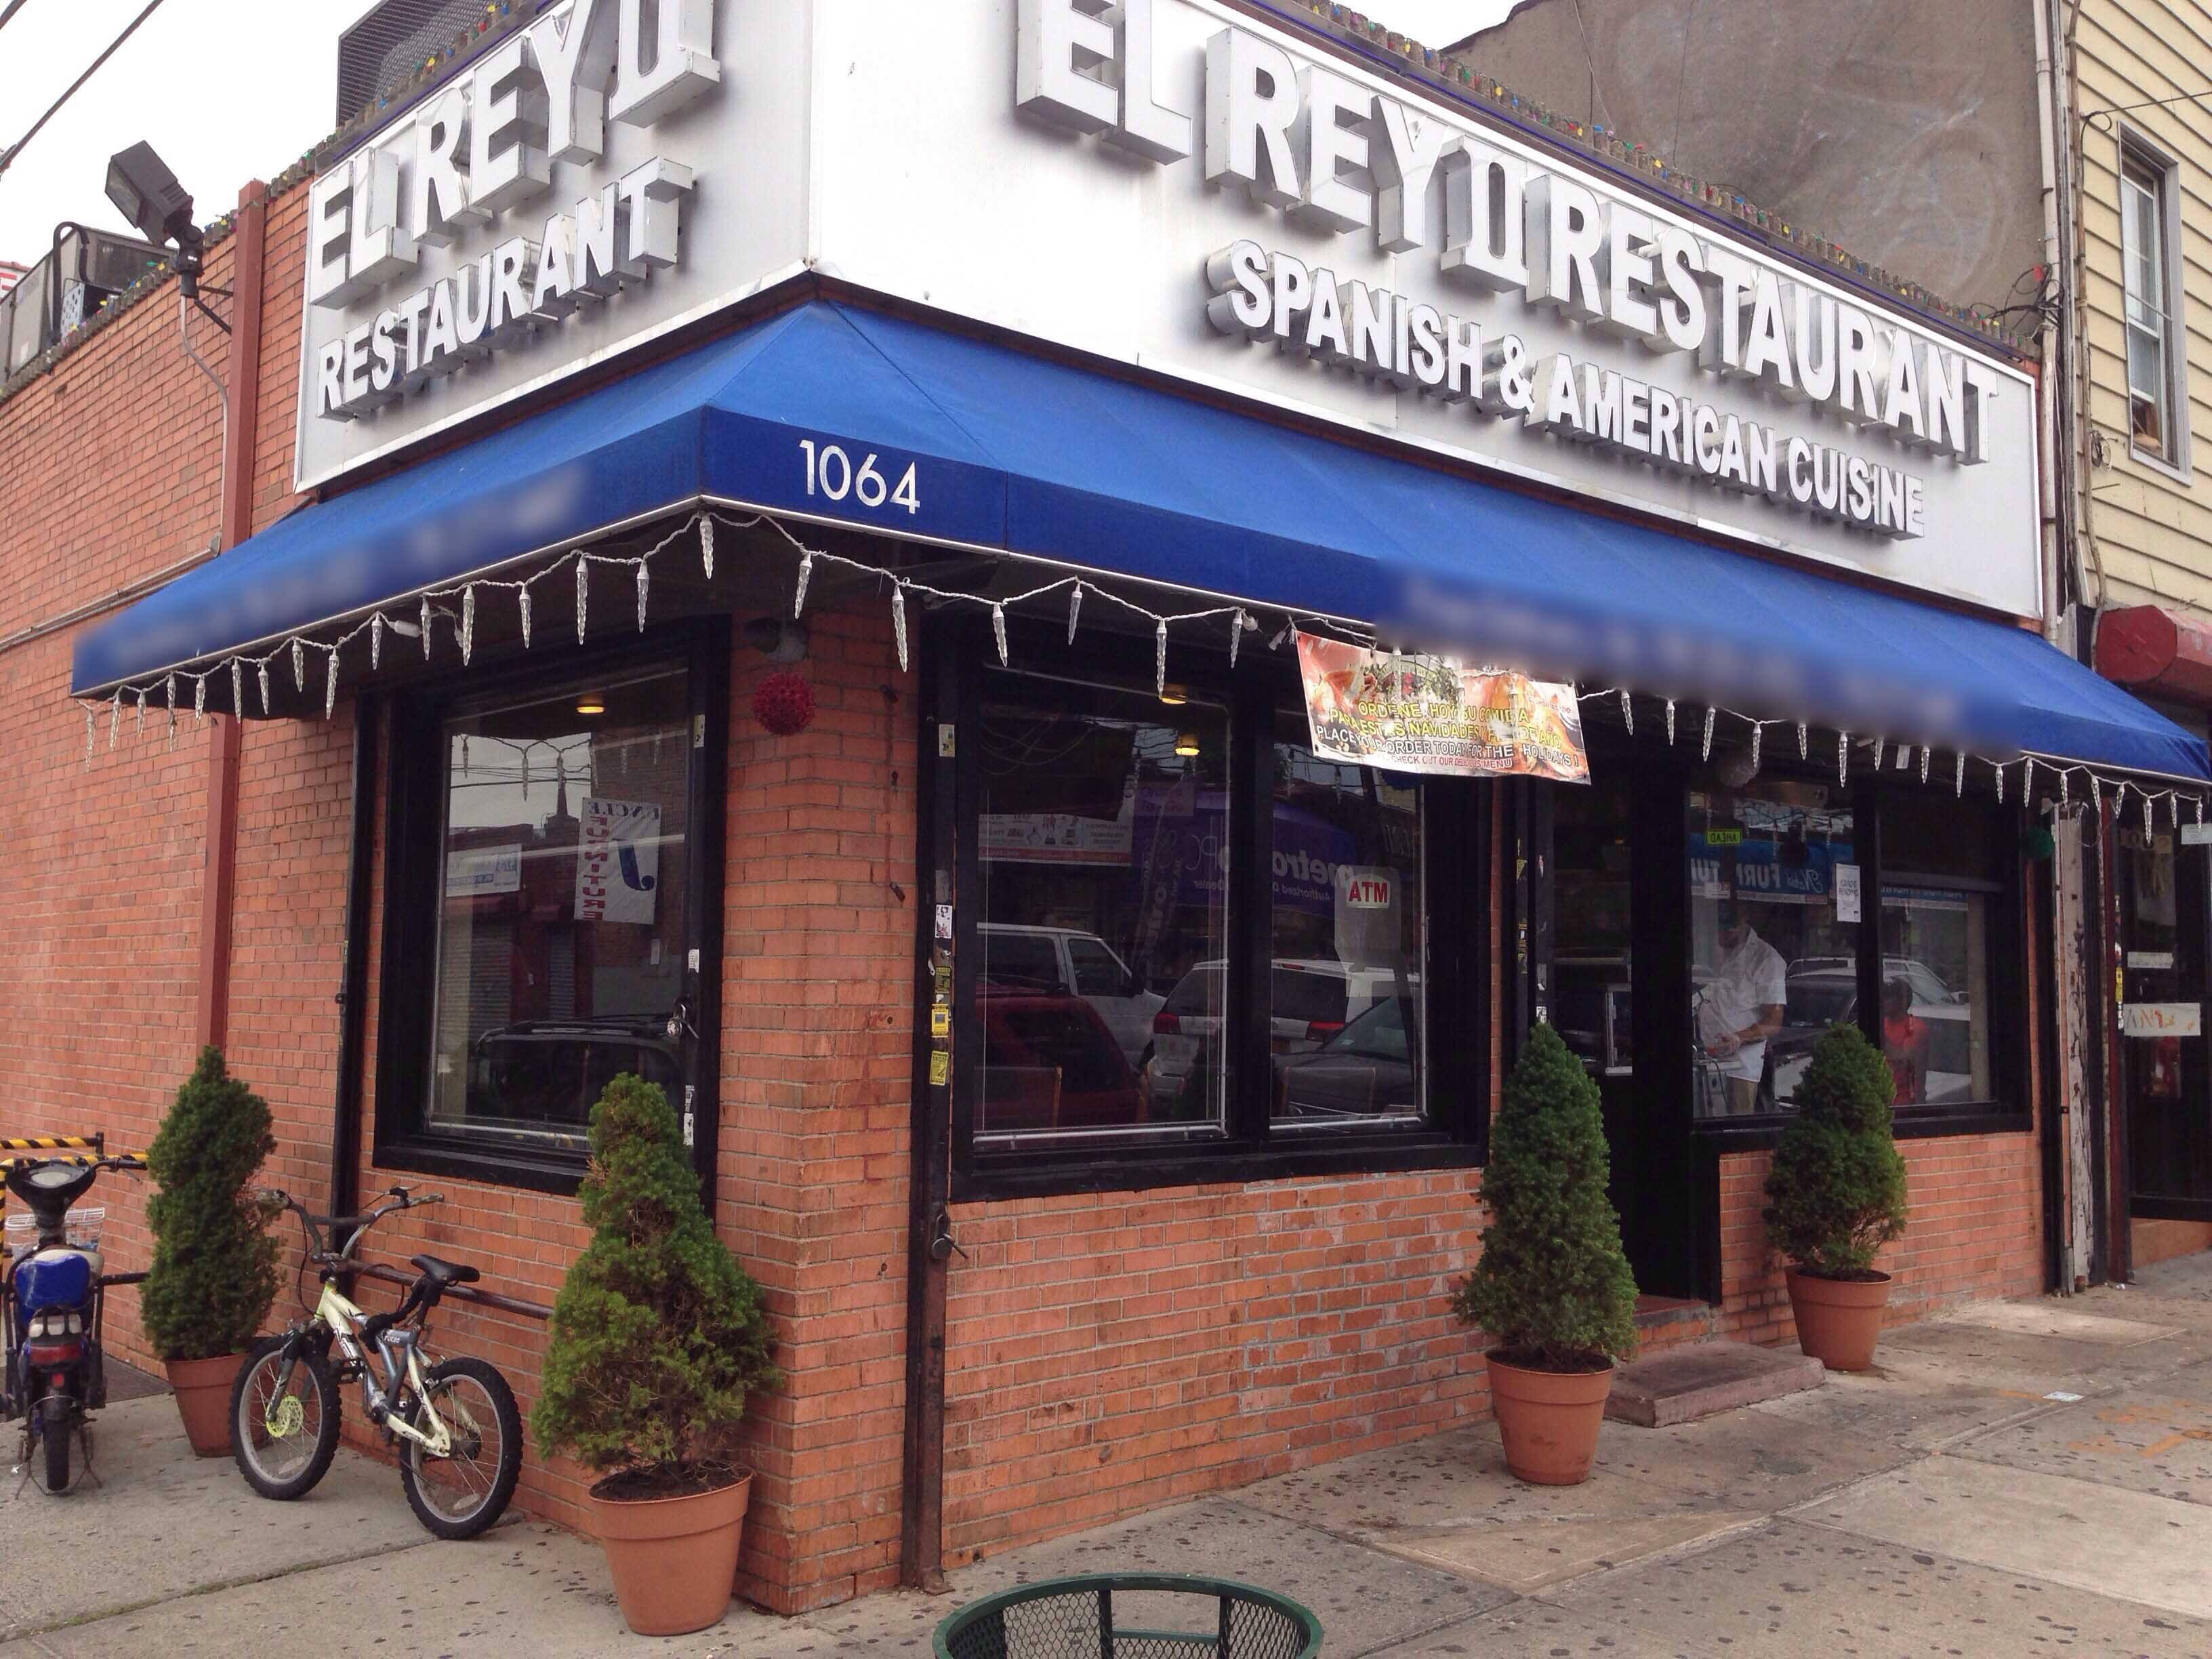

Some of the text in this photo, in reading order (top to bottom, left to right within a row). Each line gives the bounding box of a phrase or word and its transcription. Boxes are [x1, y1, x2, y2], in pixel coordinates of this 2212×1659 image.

[309, 146, 400, 308] EL
[411, 0, 596, 245] REY
[1027, 0, 1191, 157] EL
[1229, 26, 1449, 248] REY
[317, 155, 668, 420] RESTAURANT
[1548, 173, 1999, 464] RESTAURANT
[1228, 239, 1925, 537] SPANISH & AMERICAN CUISINE
[799, 439, 920, 514] 1064
[1316, 724, 1356, 743] PLACE
[1354, 734, 1384, 752] YOUR
[1385, 739, 1432, 754] ORDER
[1433, 741, 1467, 757] TODAY
[1467, 743, 1483, 758] FOR
[1484, 744, 1515, 760] THE
[1522, 742, 1572, 767] HOLIDAYS
[1329, 707, 1359, 732] PARA
[1359, 718, 1406, 738] ESTS
[1408, 721, 1479, 741] NAVIDADES
[1357, 701, 1422, 718] ORDENE
[1429, 703, 1455, 720] HOY
[1463, 705, 1477, 722] SU
[1391, 754, 1420, 764] CHECK
[1422, 755, 1437, 765] OUT
[1439, 756, 1454, 766] OUR
[1482, 758, 1513, 770] MENU
[1348, 880, 1388, 904] ATM
